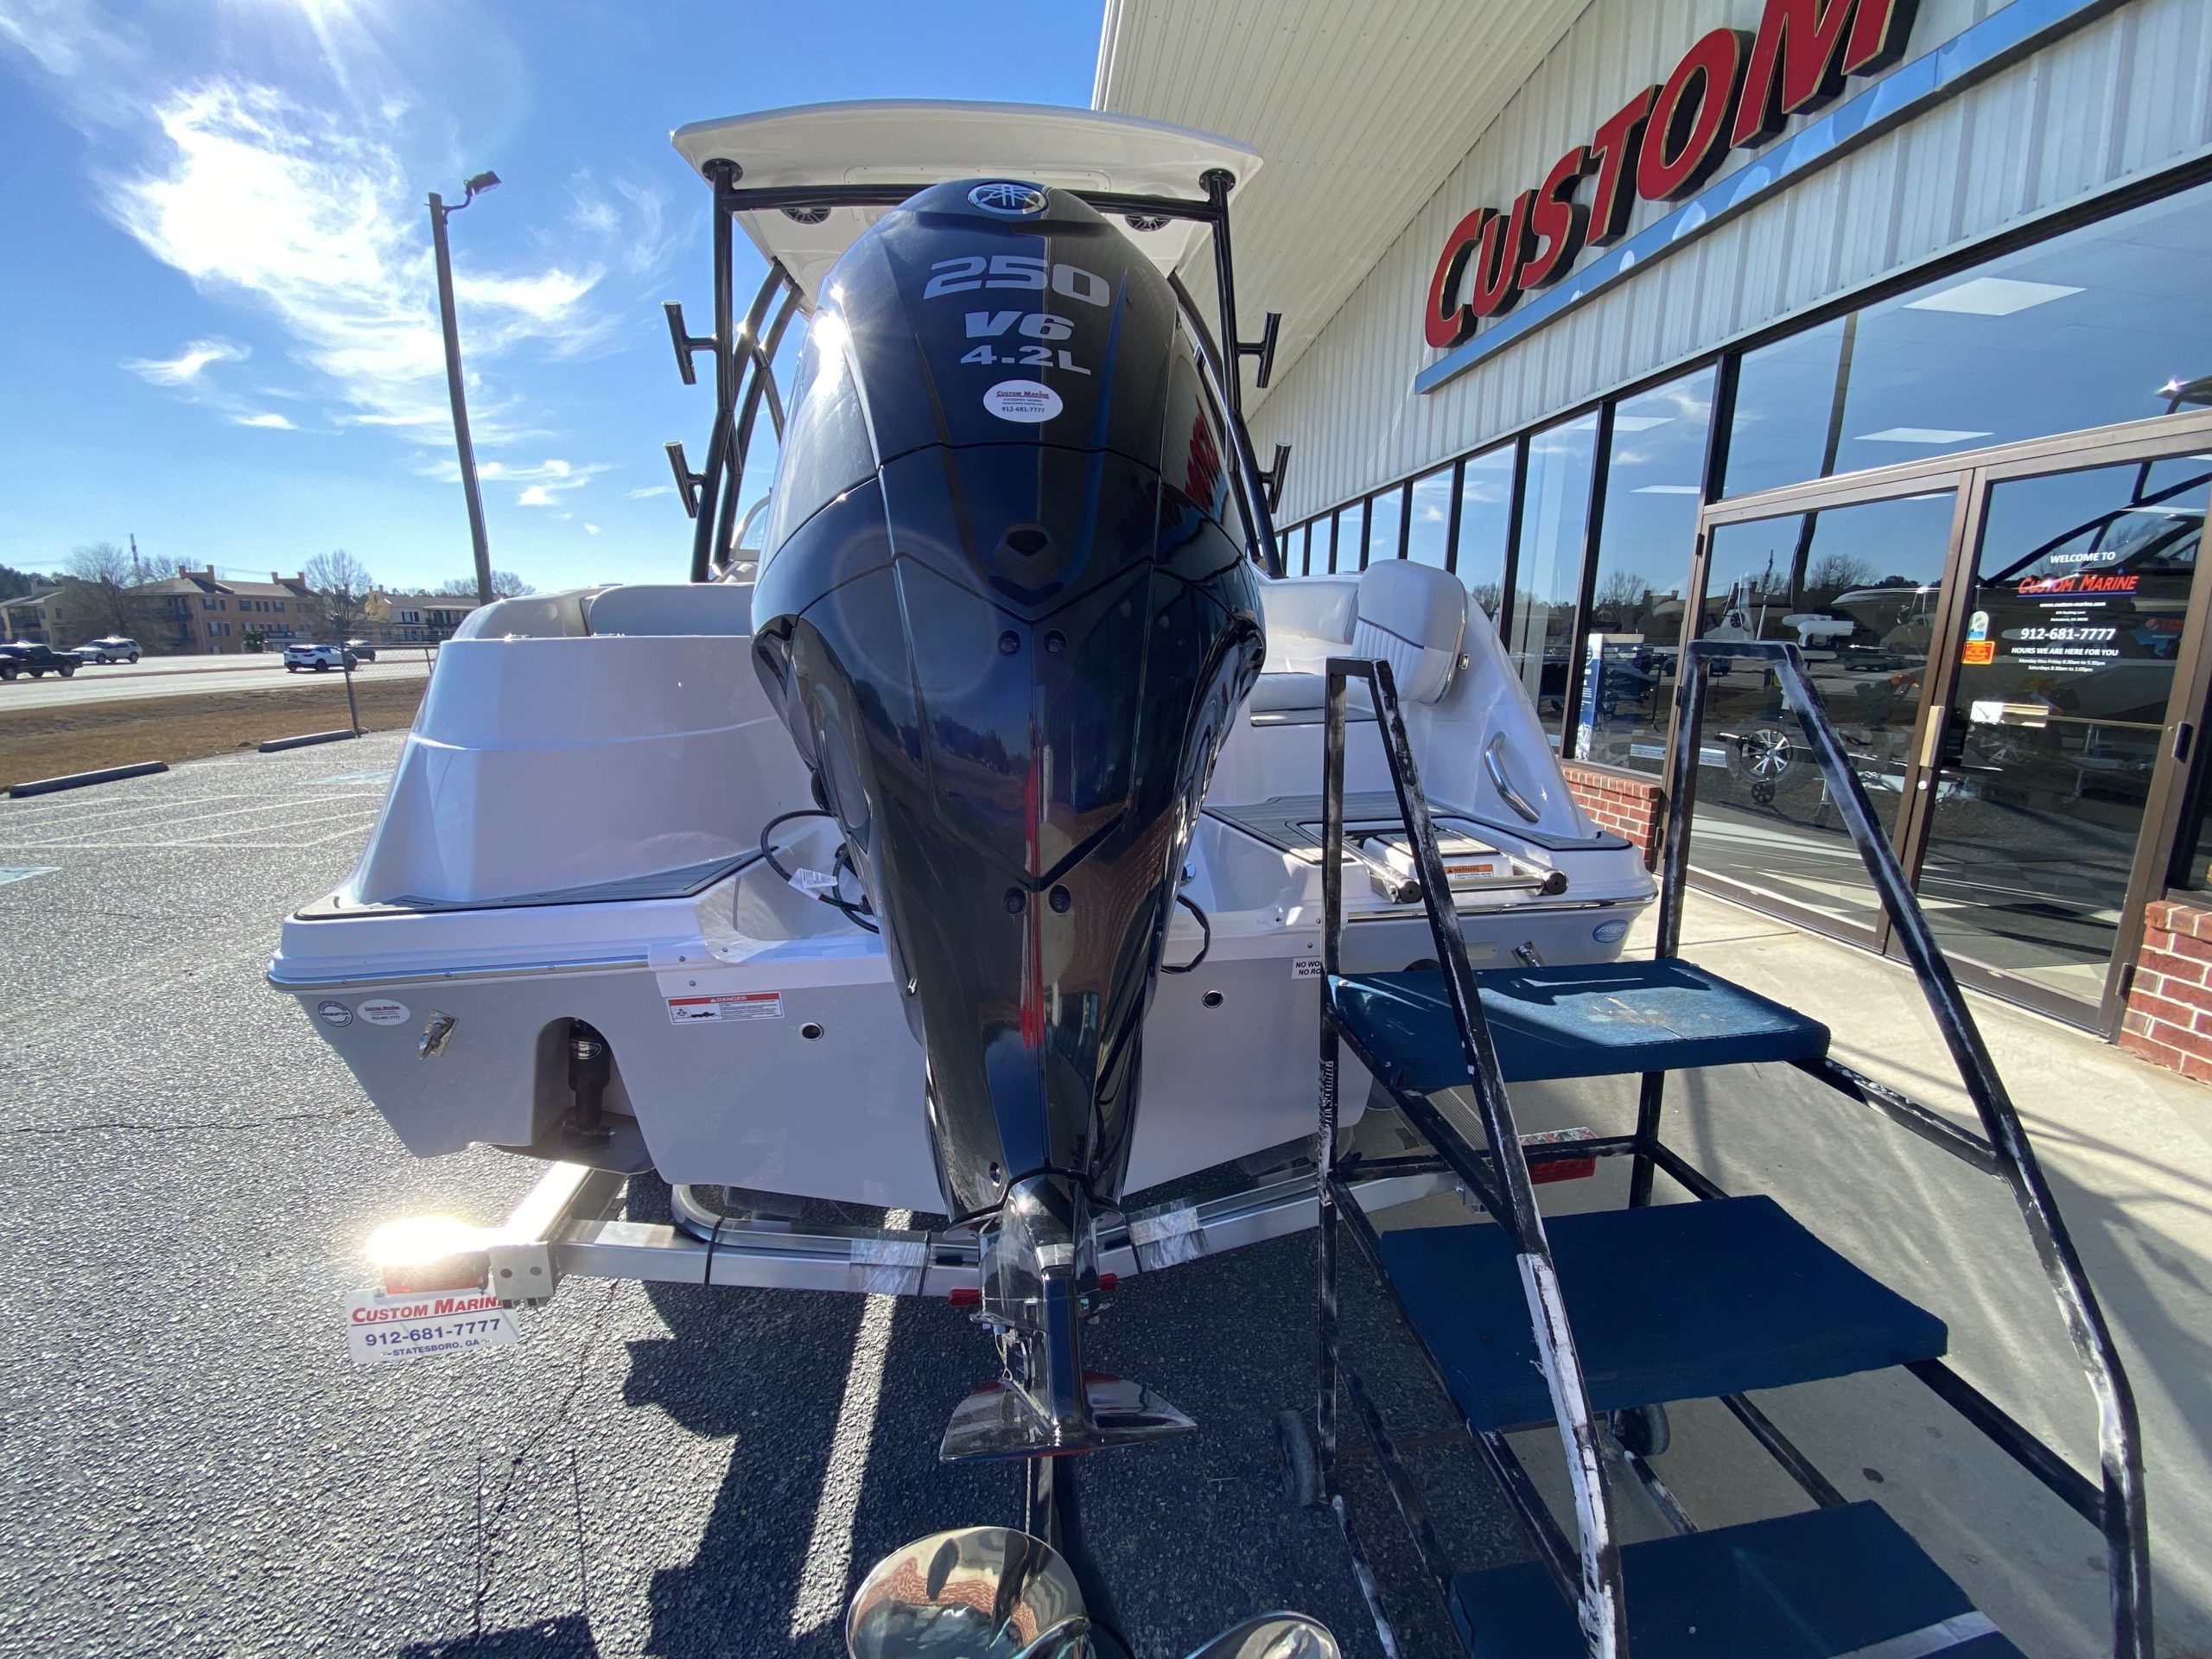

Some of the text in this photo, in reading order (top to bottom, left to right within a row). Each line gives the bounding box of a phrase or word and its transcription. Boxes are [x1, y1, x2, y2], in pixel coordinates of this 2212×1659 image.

[1425, 0, 1897, 347] CUSTOM
[924, 256, 1109, 307] 250
[965, 311, 1074, 340] V6
[960, 345, 1091, 375] 4.2L
[2050, 551, 2116, 563] WELCOME TO
[2079, 574, 2139, 592] MARINE
[2020, 627, 2116, 640] 912-681-7777
[352, 1297, 502, 1323] CUSTOM MARIN
[365, 1318, 500, 1346] 912-681-7777
